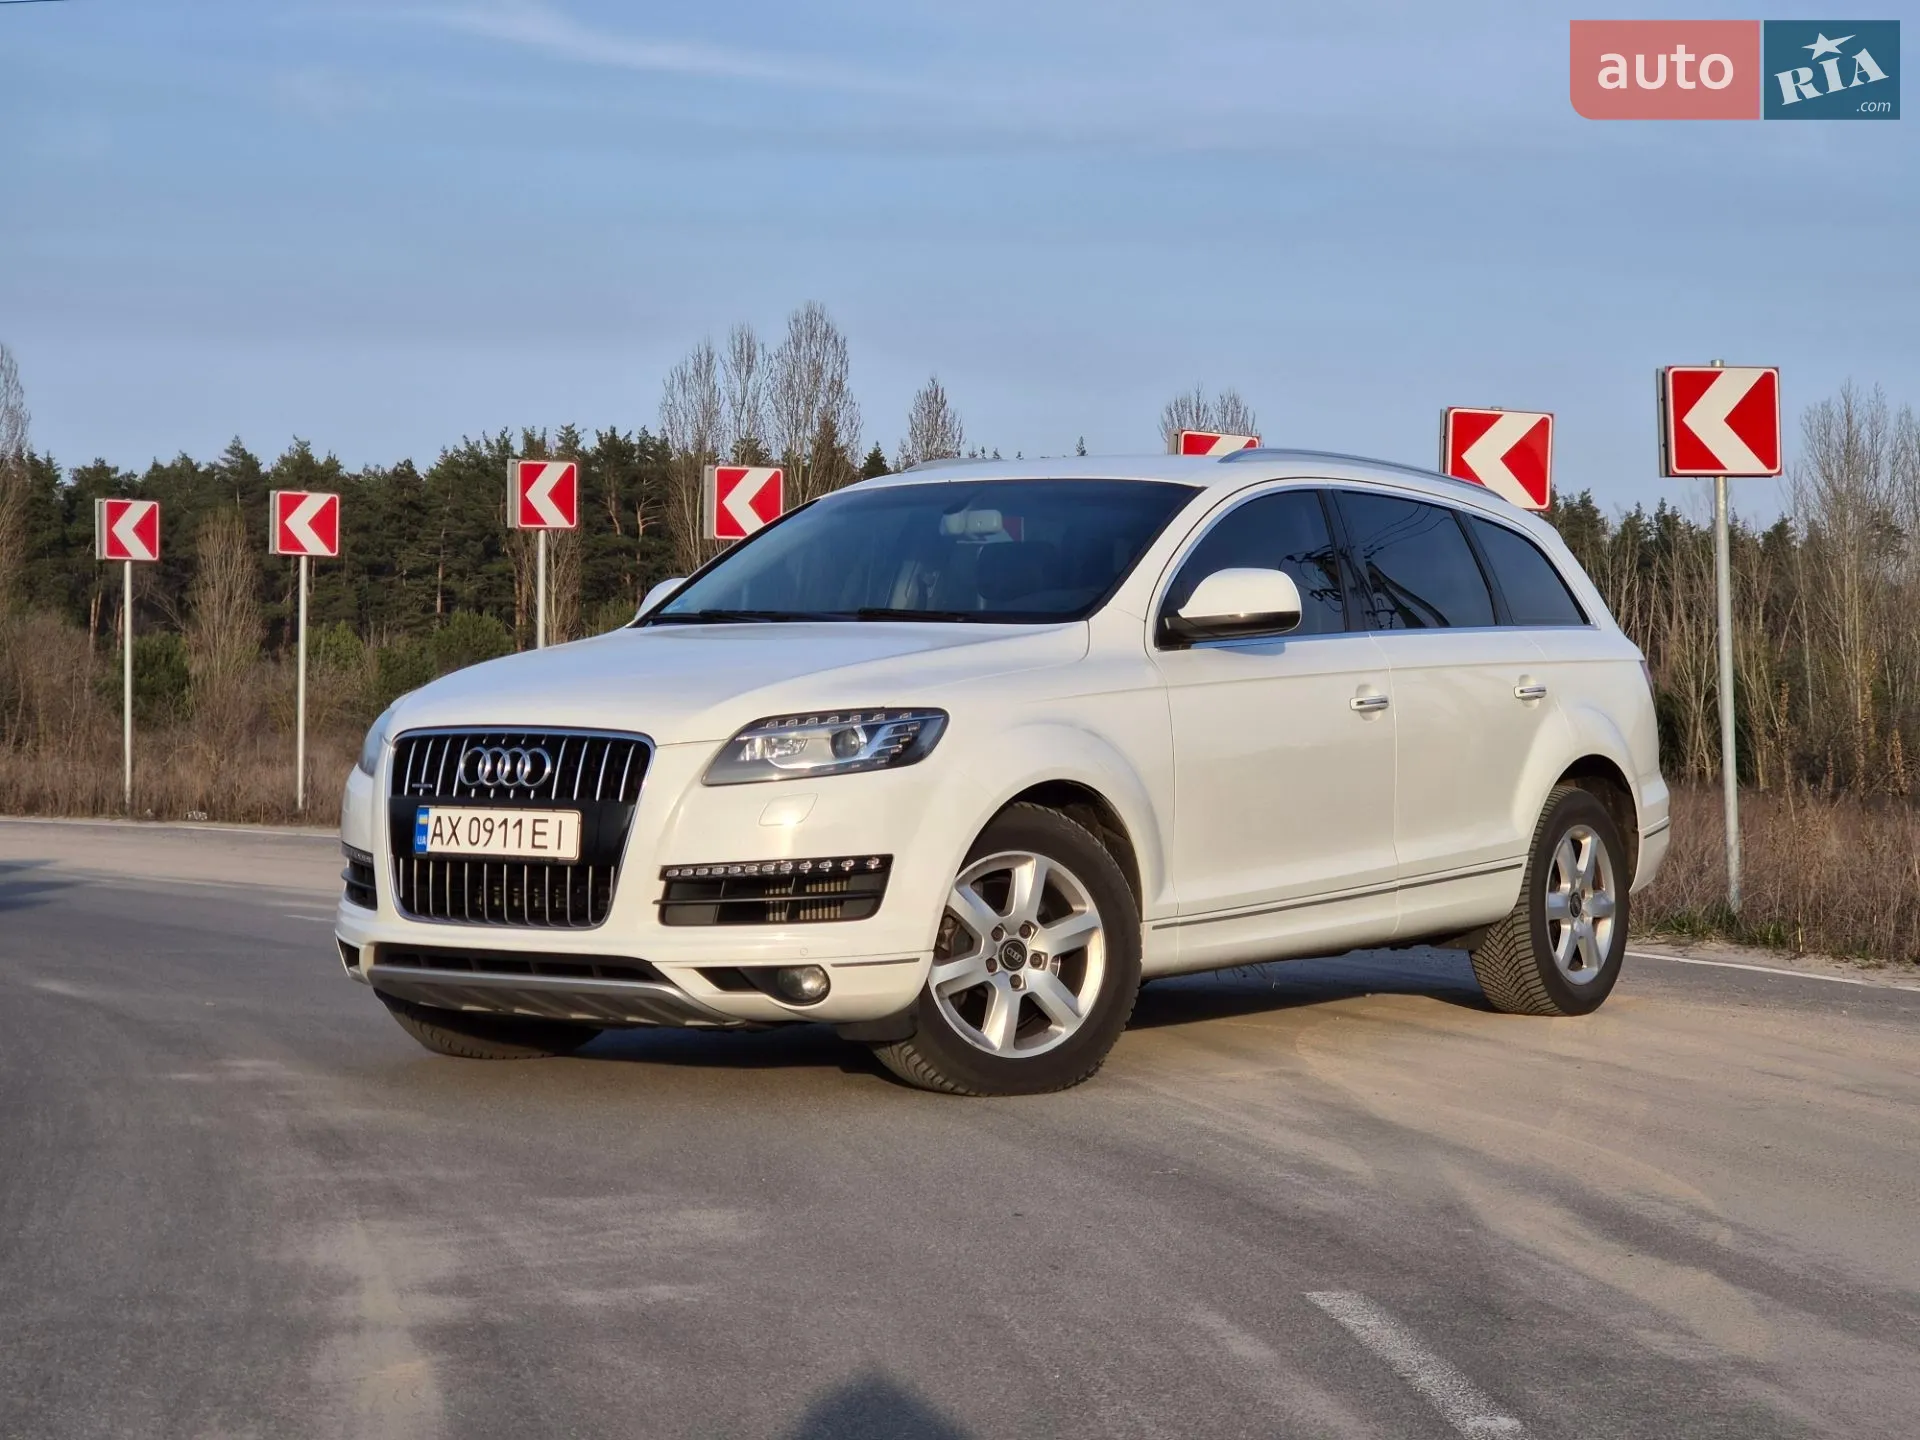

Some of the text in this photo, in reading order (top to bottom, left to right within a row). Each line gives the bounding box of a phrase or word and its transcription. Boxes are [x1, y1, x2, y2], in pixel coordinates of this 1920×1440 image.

[416, 836, 427, 846] UA
[430, 815, 563, 850] AX 0911 EI
